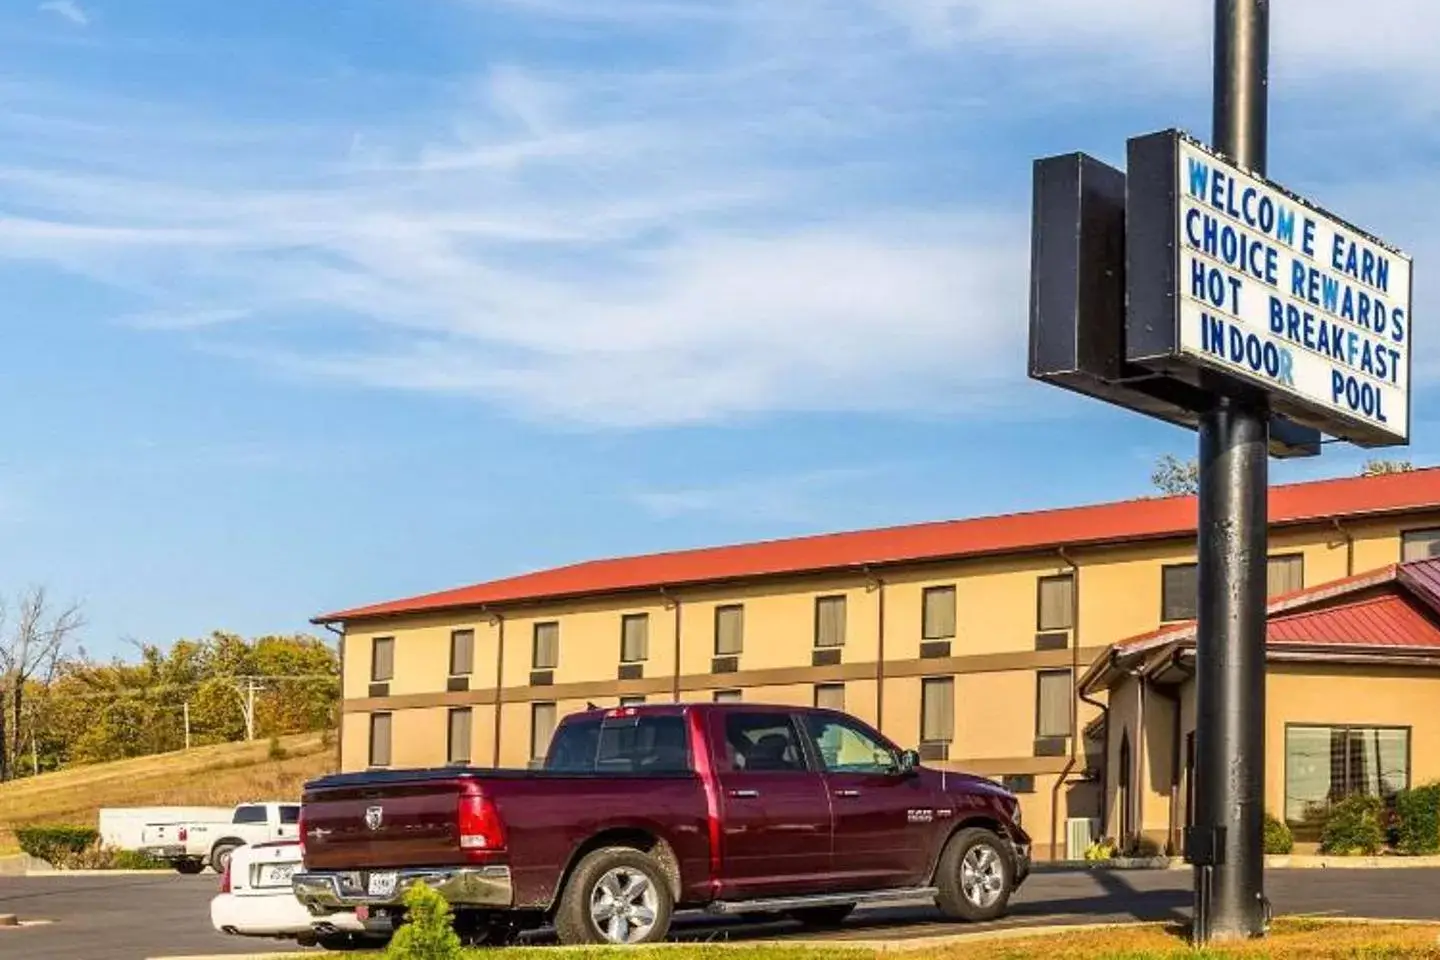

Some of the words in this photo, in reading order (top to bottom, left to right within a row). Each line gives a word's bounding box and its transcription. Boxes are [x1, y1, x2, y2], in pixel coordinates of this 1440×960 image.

[1187, 208, 1278, 285] CHOICE
[1292, 261, 1405, 341] REWARDS
[1188, 157, 1316, 256] WELCOME
[1332, 234, 1389, 292] EARN
[1191, 257, 1243, 316] HOT
[1269, 297, 1400, 384] BREAKFAST
[1201, 312, 1294, 385] INDOOR
[1332, 369, 1388, 423] POOL
